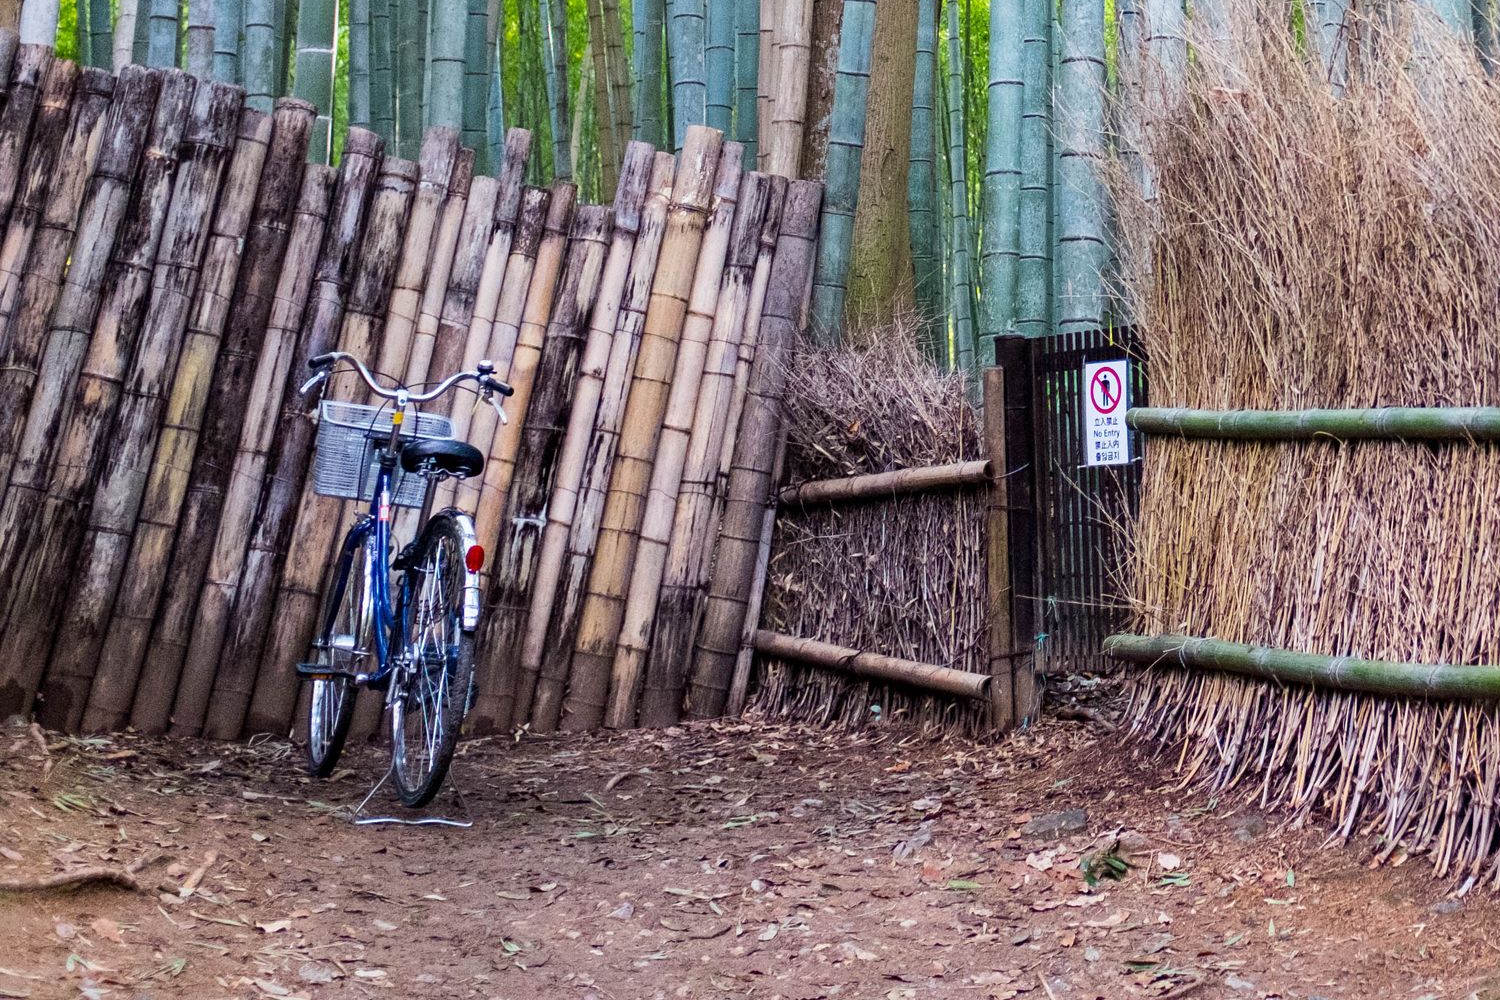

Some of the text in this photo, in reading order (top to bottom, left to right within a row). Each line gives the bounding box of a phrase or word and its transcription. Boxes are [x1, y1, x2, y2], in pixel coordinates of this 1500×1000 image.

[1094, 417, 1118, 426] 立入禁止
[1093, 429, 1120, 439] No Entry
[1096, 451, 1119, 461] 출입금지
